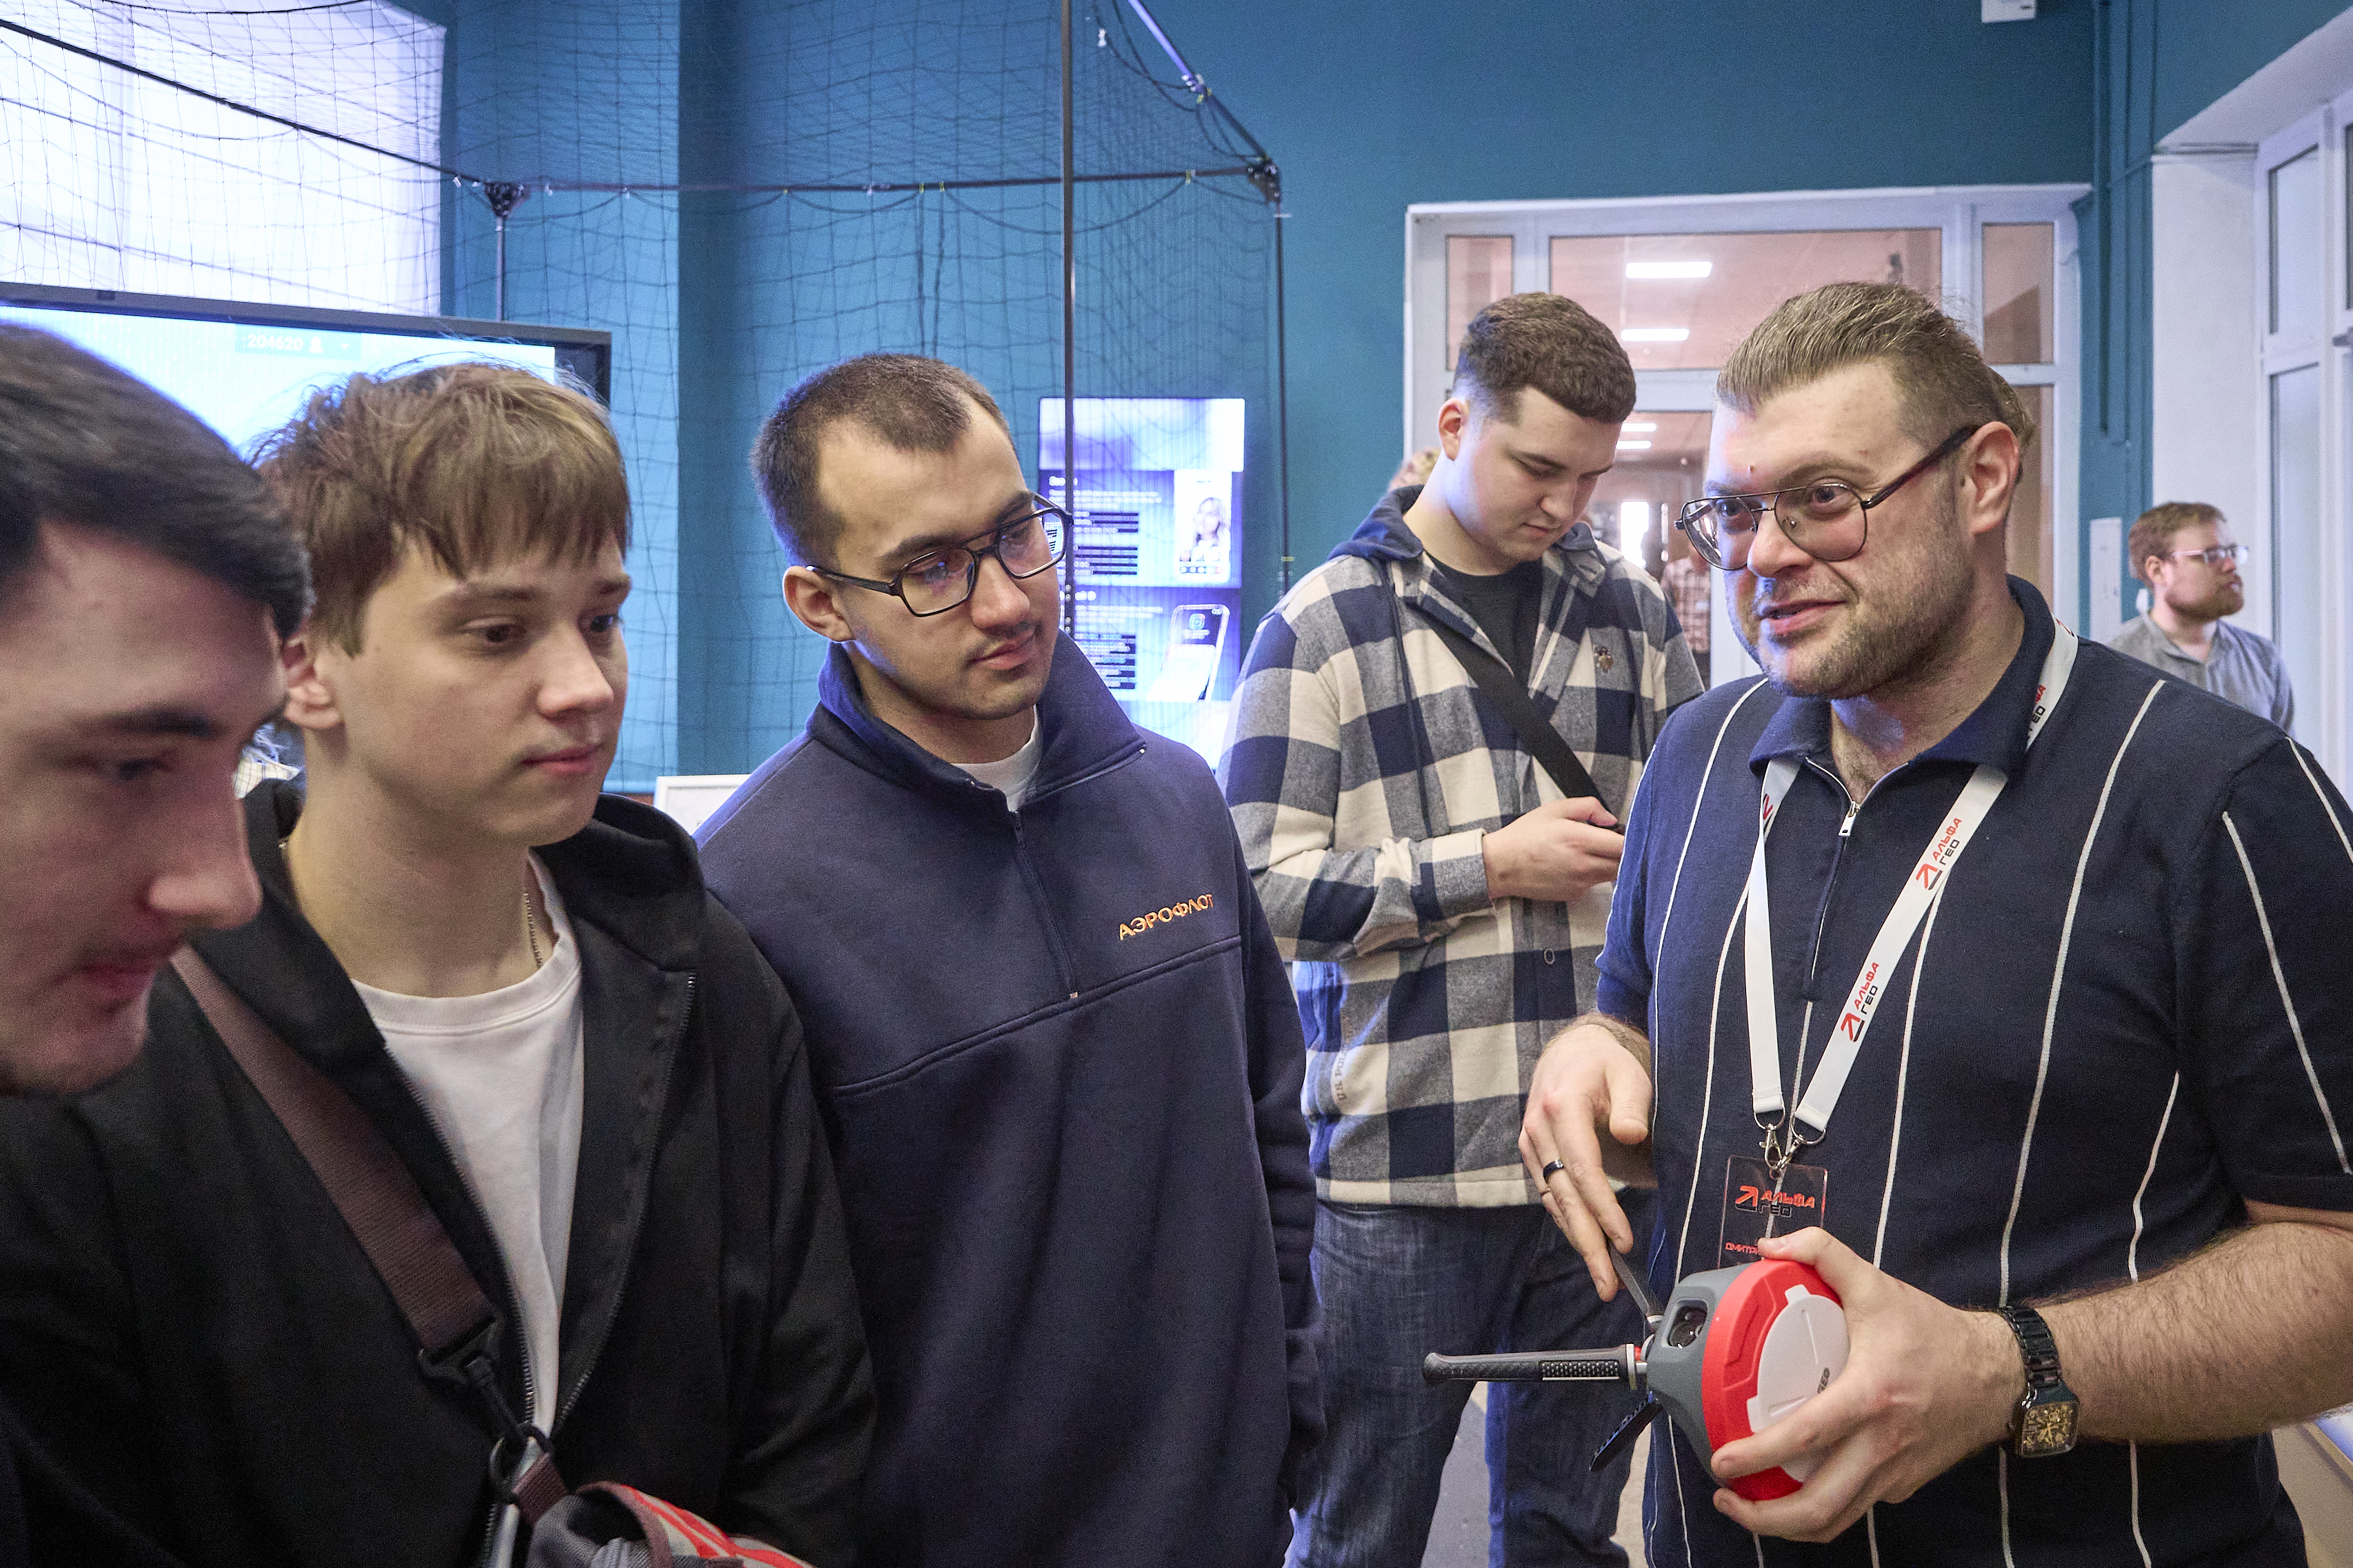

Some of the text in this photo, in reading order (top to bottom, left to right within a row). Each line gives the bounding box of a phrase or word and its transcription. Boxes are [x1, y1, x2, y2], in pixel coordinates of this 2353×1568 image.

[247, 334, 303, 351] 204620
[1932, 818, 1962, 861] АЛЬФА
[1939, 839, 1960, 865] ГЕО
[1119, 894, 1214, 941] АЭРОФЛОТ
[1854, 962, 1879, 1011] АЛЬФА
[1861, 985, 1879, 1015] ГЕО
[1759, 1203, 1792, 1218] ГЕО
[1761, 1190, 1816, 1209] АЛЬФА
